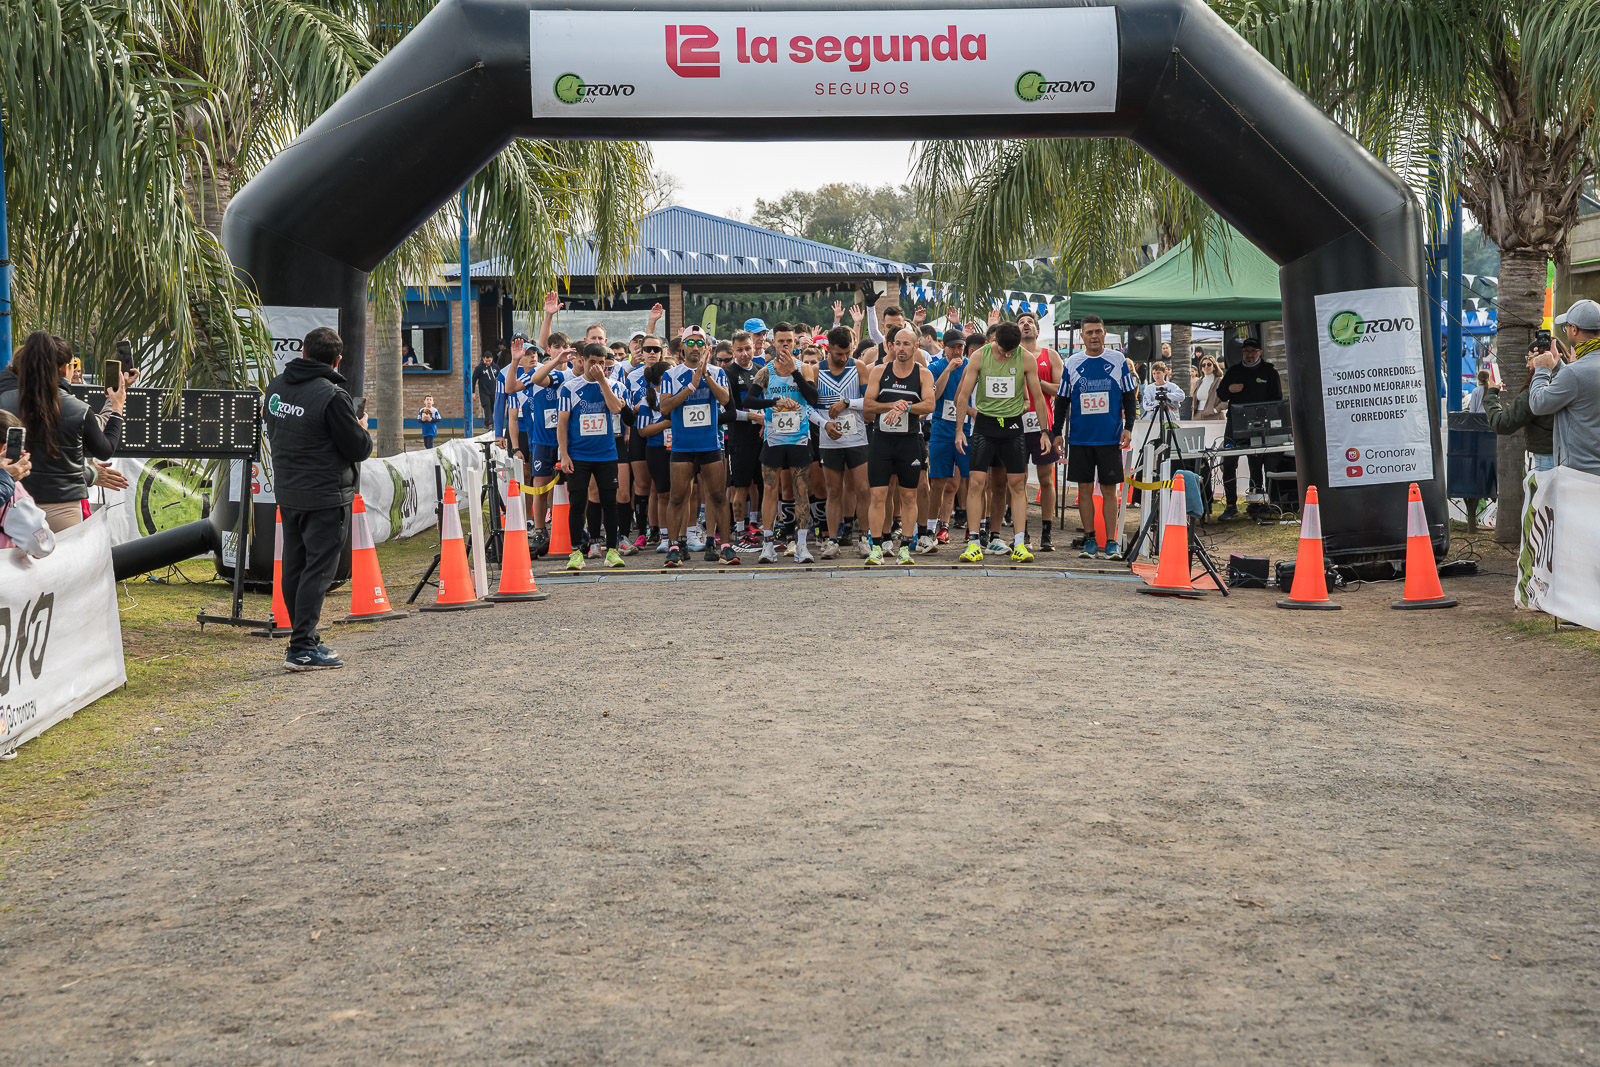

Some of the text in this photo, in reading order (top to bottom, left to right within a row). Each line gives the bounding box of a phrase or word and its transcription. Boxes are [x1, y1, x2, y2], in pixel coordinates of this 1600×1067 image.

[736, 25, 987, 72] la segunda
[576, 84, 635, 96] CRONO
[815, 81, 909, 95] SEGUROS
[1037, 81, 1095, 93] CRONO
[1353, 318, 1414, 335] CRONO
[1353, 335, 1377, 344] RAV
[1332, 365, 1416, 381] “SOMOS CORREDORES
[992, 383, 1008, 393] 83
[1327, 380, 1422, 396] BUSCANDO MEJORAR LAS
[1083, 397, 1106, 409] 516
[1335, 394, 1418, 410] EXPERIENCIAS DE LOS
[689, 410, 705, 422] 20
[1350, 409, 1408, 423] CORREDORES”
[582, 419, 604, 430] 517
[777, 417, 794, 429] 64
[1026, 418, 1040, 428] 82
[1365, 448, 1416, 460] Cronorav
[1366, 463, 1417, 475] Cronorav
